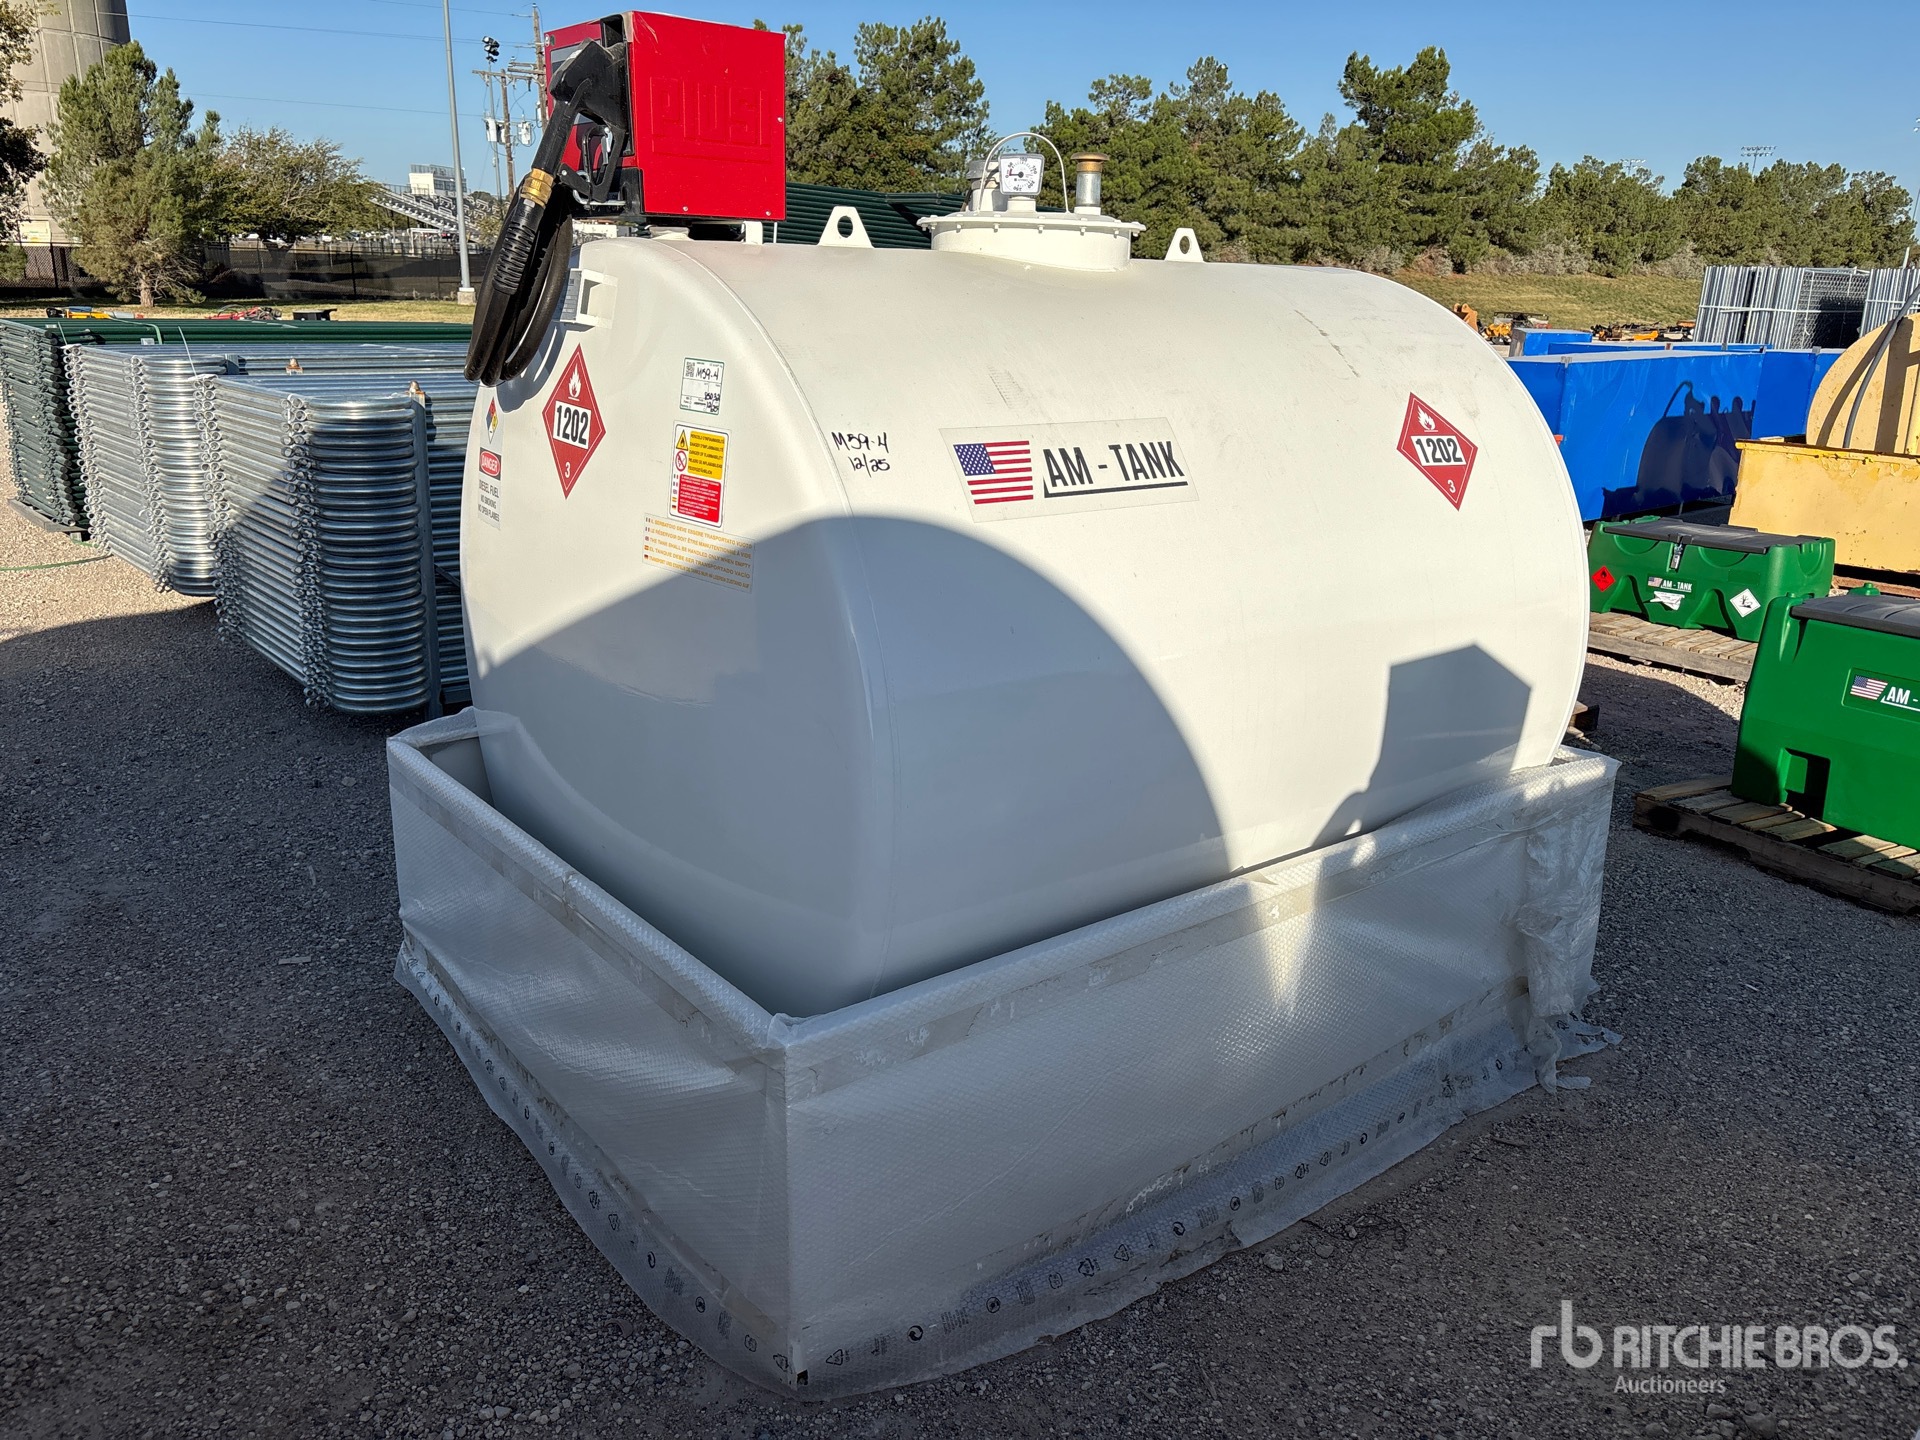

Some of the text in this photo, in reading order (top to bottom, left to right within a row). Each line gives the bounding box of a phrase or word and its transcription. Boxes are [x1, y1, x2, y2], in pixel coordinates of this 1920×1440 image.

[556, 405, 589, 446] 1202
[1415, 437, 1463, 463] 1202
[481, 454, 498, 472] DANGER
[564, 461, 571, 478] 3
[847, 452, 890, 478] 12/25
[1042, 446, 1094, 488] AM
[1108, 440, 1185, 482] TANK
[490, 485, 500, 498] FUEL
[1447, 479, 1456, 493] 3
[704, 532, 735, 544] TRASPORTATO
[1677, 581, 1692, 591] TANK
[1886, 686, 1911, 705] AM
